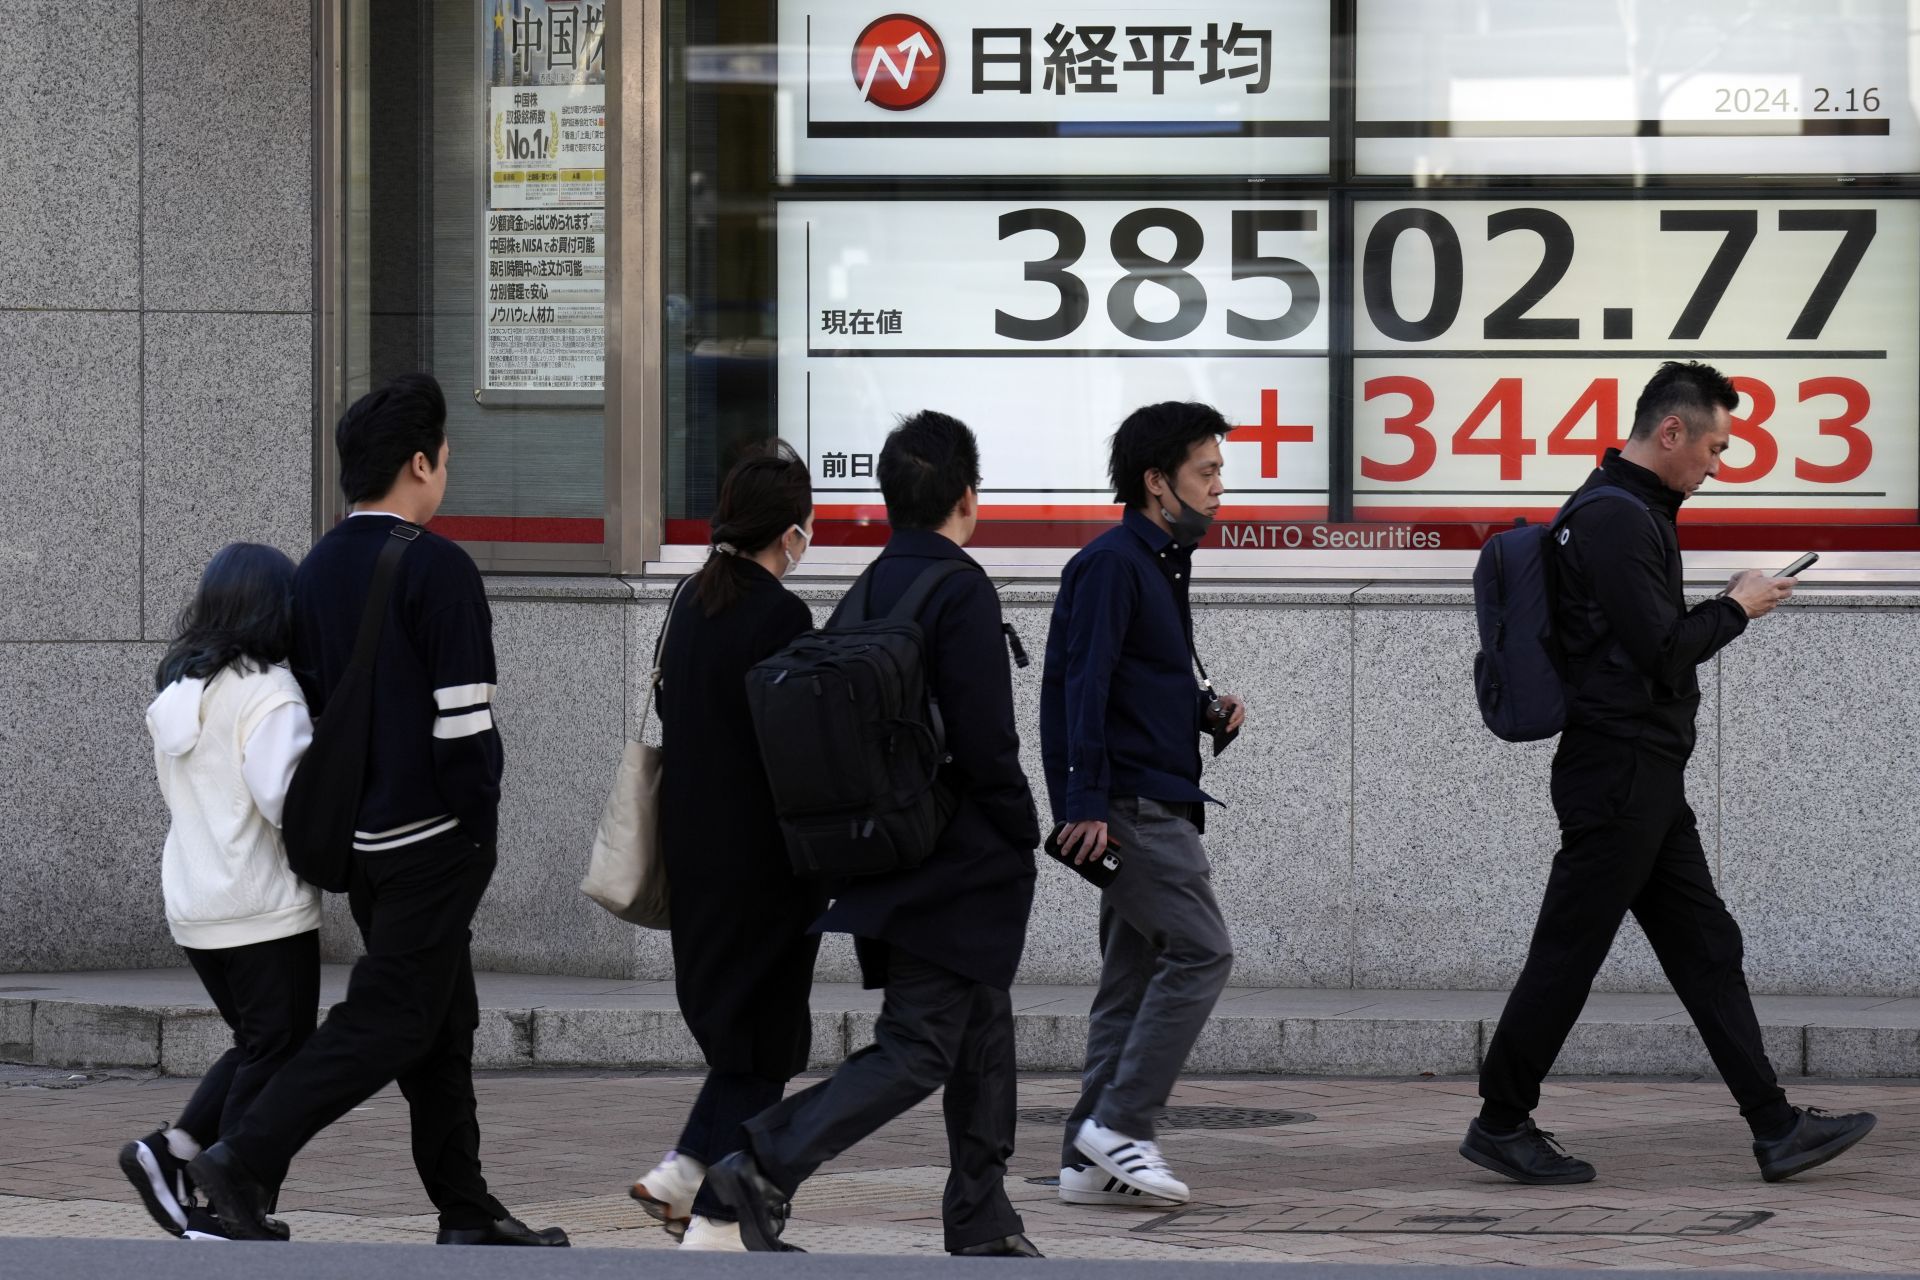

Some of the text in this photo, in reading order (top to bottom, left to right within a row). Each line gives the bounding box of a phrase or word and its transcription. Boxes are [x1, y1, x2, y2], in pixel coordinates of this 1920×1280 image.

[971, 22, 1273, 95] 日経平均
[514, 92, 538, 108] 中国株
[1714, 87, 1880, 113] 2024. 2.16
[506, 128, 549, 159] No.1!
[490, 213, 590, 232] 少額資金からはじめられます
[490, 236, 595, 255] 中国株もNISAでお買付可能
[490, 260, 583, 277] 取引時間中の注文が可能
[490, 283, 548, 300] 分別管理で安心
[490, 306, 555, 324] ノウハウと人材力
[821, 308, 902, 335] 現在値
[1226, 376, 1874, 484] +34483
[822, 452, 881, 478] 前日
[1221, 525, 1441, 548] NAITO Securities
